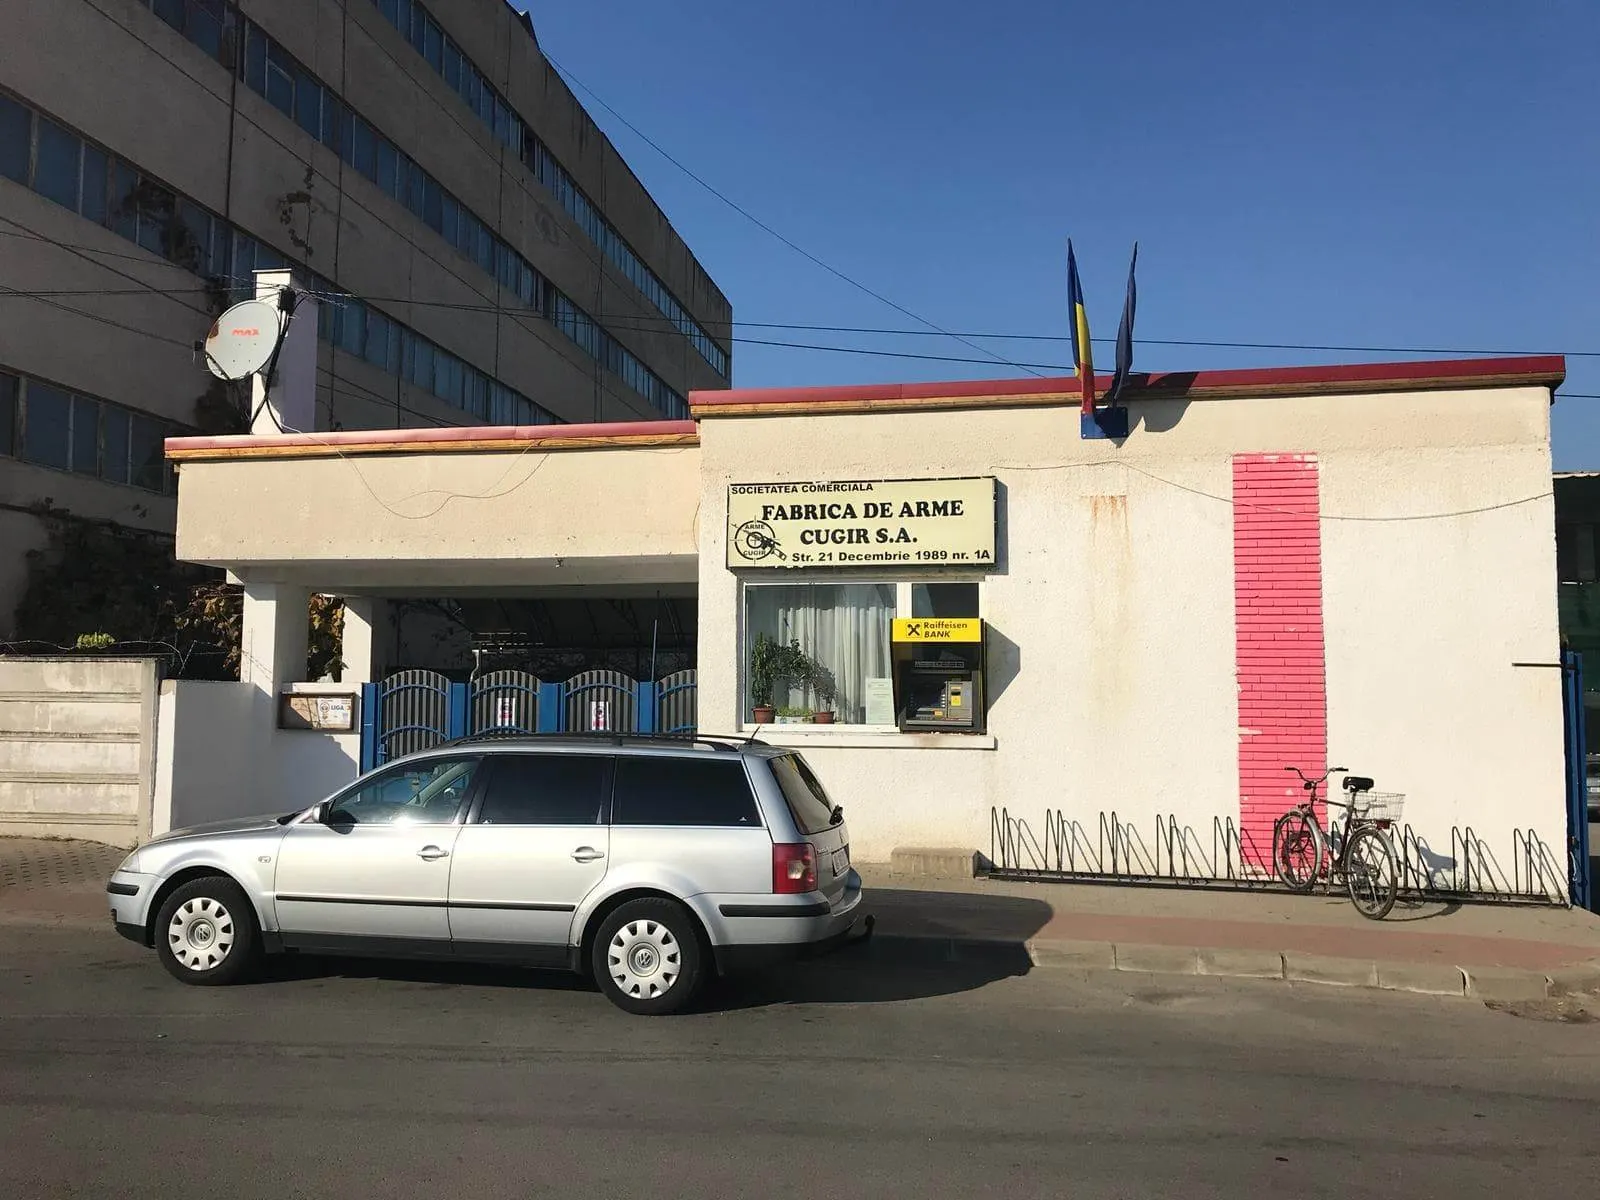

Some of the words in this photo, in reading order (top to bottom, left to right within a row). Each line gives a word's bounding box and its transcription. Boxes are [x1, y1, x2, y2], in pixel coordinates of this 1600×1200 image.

[731, 485, 799, 495] SOCIETATEA
[801, 483, 873, 493] COMERCIALA
[762, 503, 857, 521] FABRICA
[864, 502, 893, 519] DE
[899, 500, 964, 518] ARME
[800, 528, 871, 545] CUGIR
[876, 527, 918, 544] S.A.
[792, 551, 813, 562] Str.
[818, 552, 833, 562] 21
[838, 550, 910, 562] Decembrie
[915, 550, 948, 561] 1989
[953, 551, 969, 560] nr.
[974, 549, 990, 560] 1A
[923, 621, 968, 629] Raiffeisen
[924, 630, 951, 638] BANK
